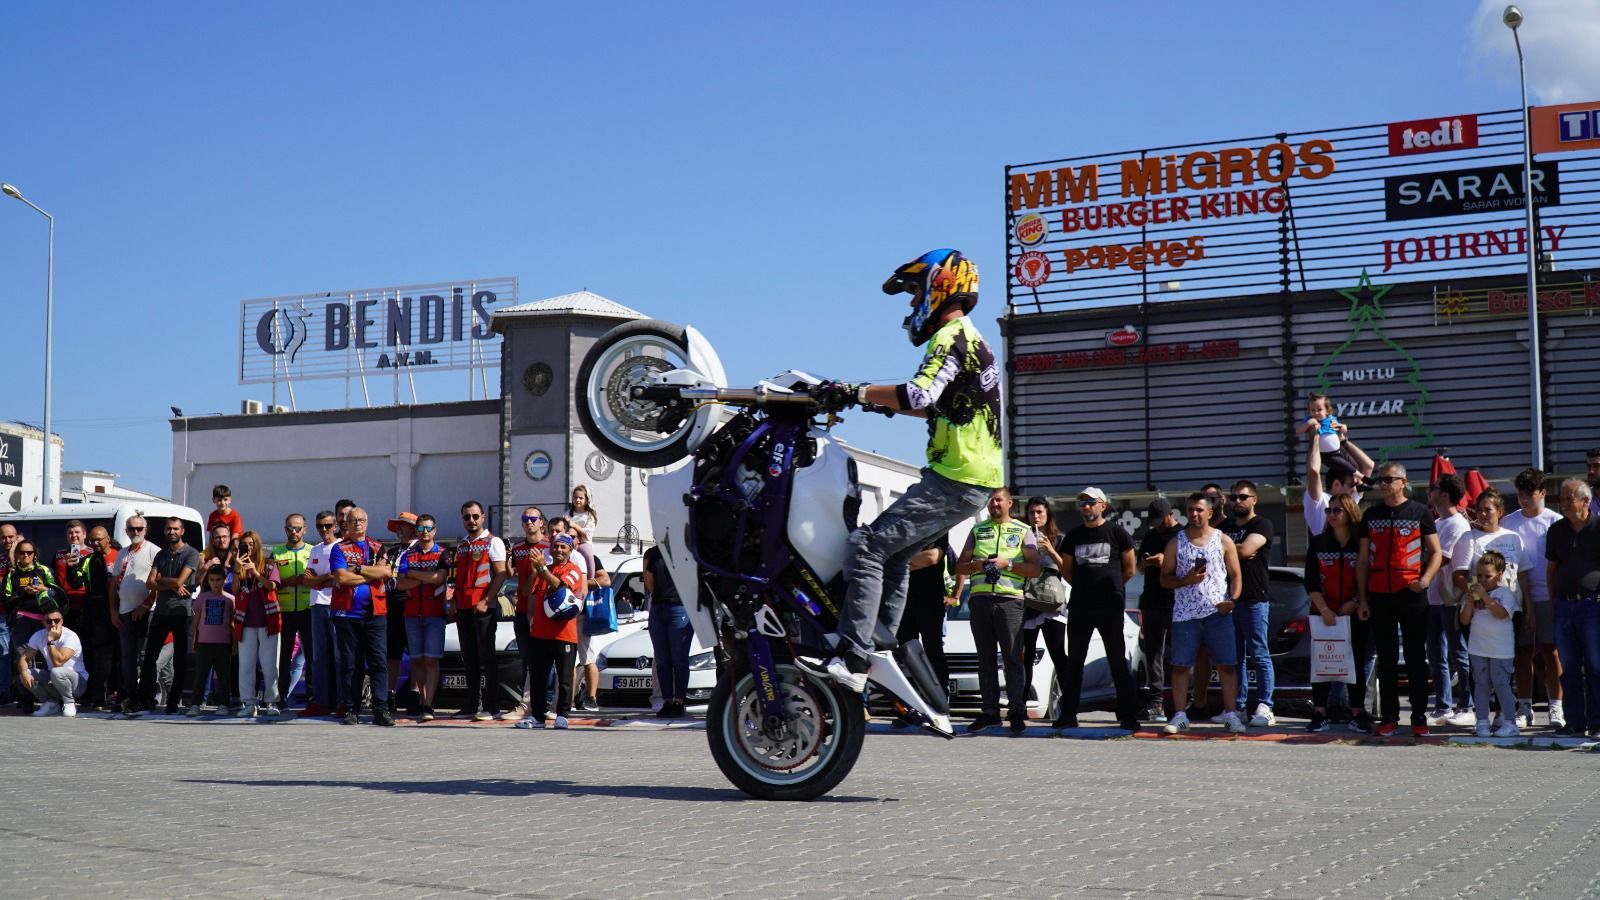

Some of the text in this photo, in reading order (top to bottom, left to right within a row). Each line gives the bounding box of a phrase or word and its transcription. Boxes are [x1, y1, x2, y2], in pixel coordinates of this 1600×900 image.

[1402, 118, 1464, 150] tedi
[1010, 163, 1099, 211] MM
[1398, 168, 1547, 205] SARAR
[1062, 186, 1287, 233] BURGER KING
[1463, 195, 1549, 211] SARAR WOAN
[1019, 223, 1043, 239] KING
[1487, 290, 1572, 313] Busa
[325, 287, 497, 351] BENDİS
[376, 350, 438, 368] A.Y.M.
[1342, 367, 1395, 381] MUTLU
[1336, 399, 1404, 416] YILLAR
[772, 442, 785, 465] elf
[617, 678, 627, 688] 59
[629, 678, 644, 687] AHT
